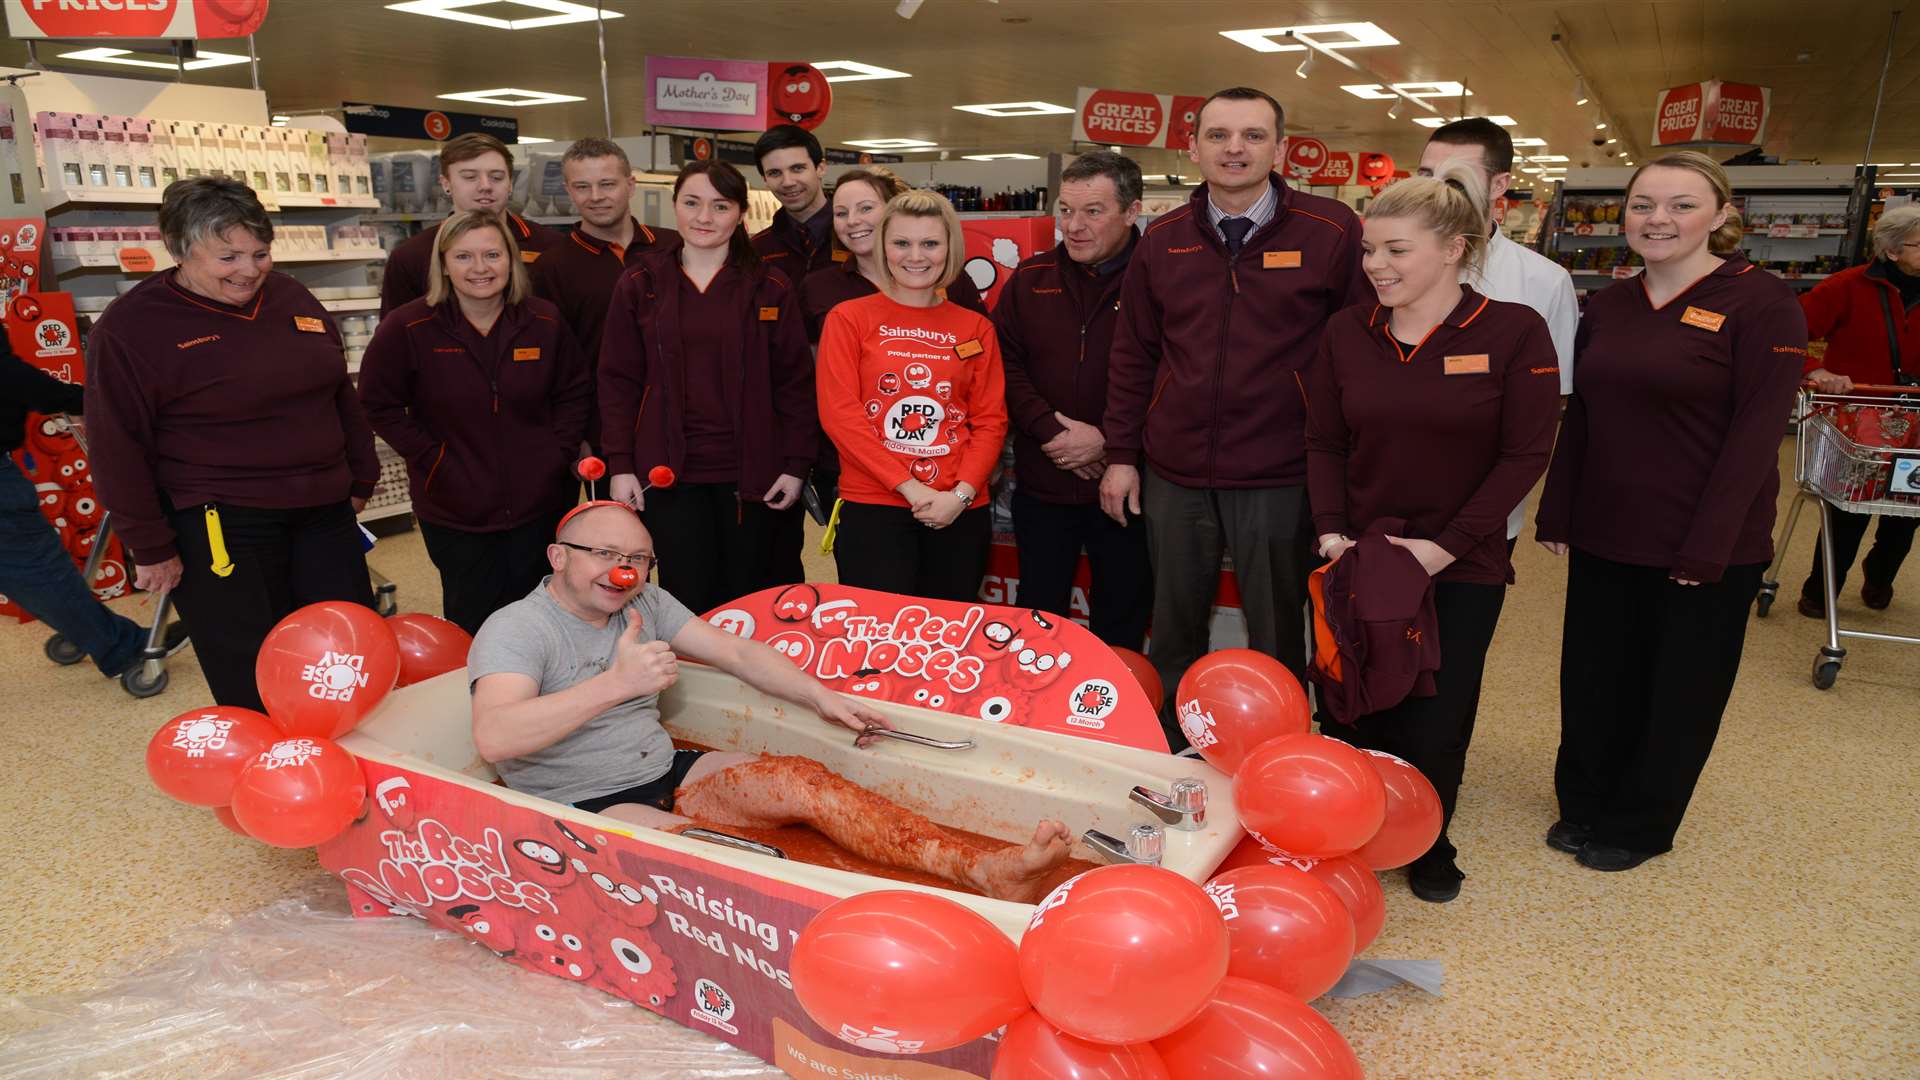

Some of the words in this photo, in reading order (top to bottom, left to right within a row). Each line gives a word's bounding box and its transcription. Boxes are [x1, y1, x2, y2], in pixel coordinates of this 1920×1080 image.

[662, 83, 718, 100] Mother's
[721, 86, 751, 106] Day
[1093, 102, 1156, 120] GREAT
[1665, 98, 1699, 117] GREAT
[1719, 97, 1759, 117] GREAT
[433, 119, 444, 133] 3
[480, 117, 517, 131] Cookshop
[1087, 116, 1156, 134] PRICES
[1660, 113, 1698, 132] PRICES
[1324, 168, 1350, 177] ICES
[1327, 160, 1349, 170] EAT
[42, 323, 61, 332] RED
[879, 325, 957, 344] Sainsbury's
[45, 339, 63, 347] DAY
[887, 350, 911, 358] Proud
[911, 353, 941, 361] partner
[901, 404, 935, 417] RED
[895, 429, 927, 441] DAY
[918, 447, 946, 456] March
[844, 616, 895, 640] The
[891, 605, 984, 651] Red
[317, 650, 365, 671] DAY
[308, 682, 356, 702] RED
[1084, 683, 1110, 696] RED
[1076, 703, 1104, 716] DAY
[1079, 718, 1102, 727] March
[172, 719, 200, 750] DAY
[207, 720, 233, 751] RED
[266, 754, 310, 770] DAY
[380, 830, 430, 862] The
[1216, 883, 1240, 921] DAY
[648, 874, 780, 952] Raising
[664, 910, 730, 957] Red
[702, 981, 724, 998] RED
[704, 999, 725, 1017] DAY
[810, 1059, 838, 1077] are
